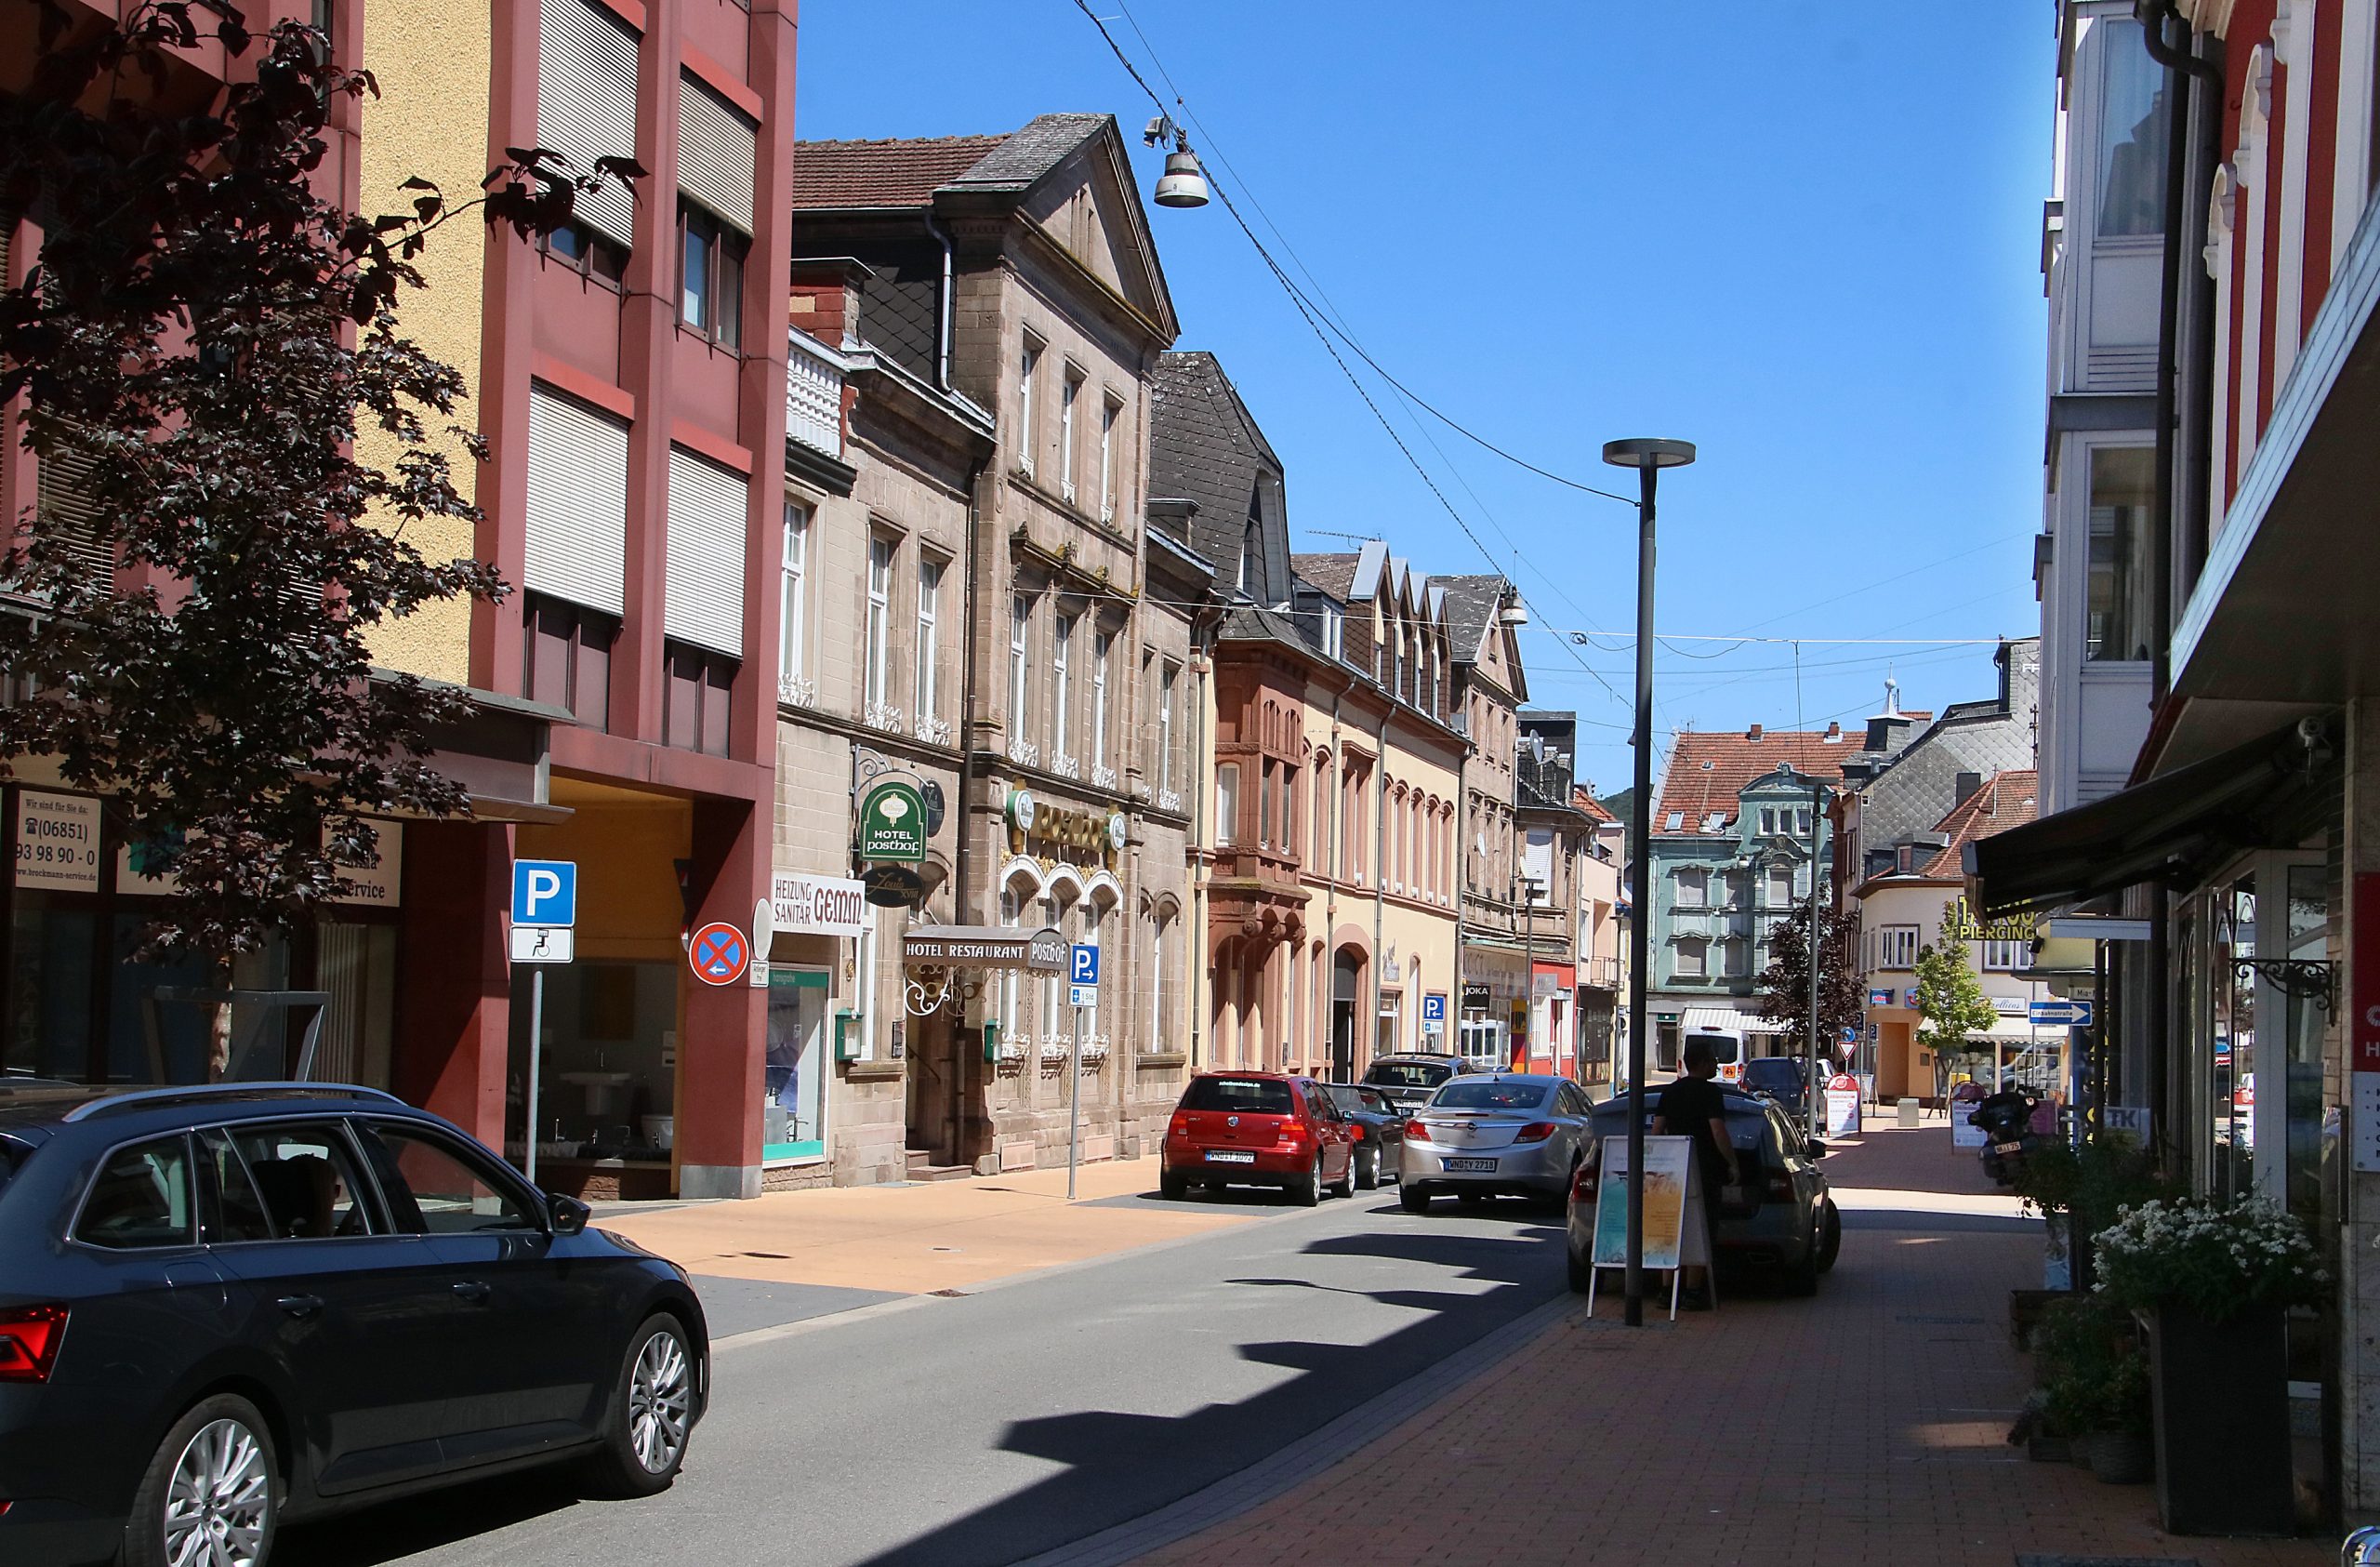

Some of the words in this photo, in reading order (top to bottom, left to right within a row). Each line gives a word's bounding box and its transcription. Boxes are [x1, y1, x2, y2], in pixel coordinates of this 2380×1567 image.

[26, 799, 37, 808] Wir
[39, 801, 53, 810] sind
[56, 802, 65, 811] für
[38, 819, 88, 844] (06851)
[874, 830, 914, 840] HOTEL
[17, 843, 32, 860] 93
[37, 845, 53, 862] 98
[58, 847, 74, 864] 90
[86, 850, 95, 866] 0
[867, 840, 919, 854] posthof
[348, 880, 386, 898] ervice
[526, 870, 561, 917] P
[775, 879, 812, 901] HEIZUNG
[774, 902, 812, 925] SANITÄR
[1960, 925, 2035, 939] PIERCING
[906, 943, 944, 956] HOTEL
[948, 944, 1025, 959] RESTAURANT
[1075, 949, 1091, 979] P
[1464, 987, 1488, 996] JOKA
[1426, 1000, 1438, 1017] P
[2108, 1109, 2136, 1129] TK
[1450, 1160, 1464, 1168] WND
[1474, 1161, 1494, 1169] 2718
